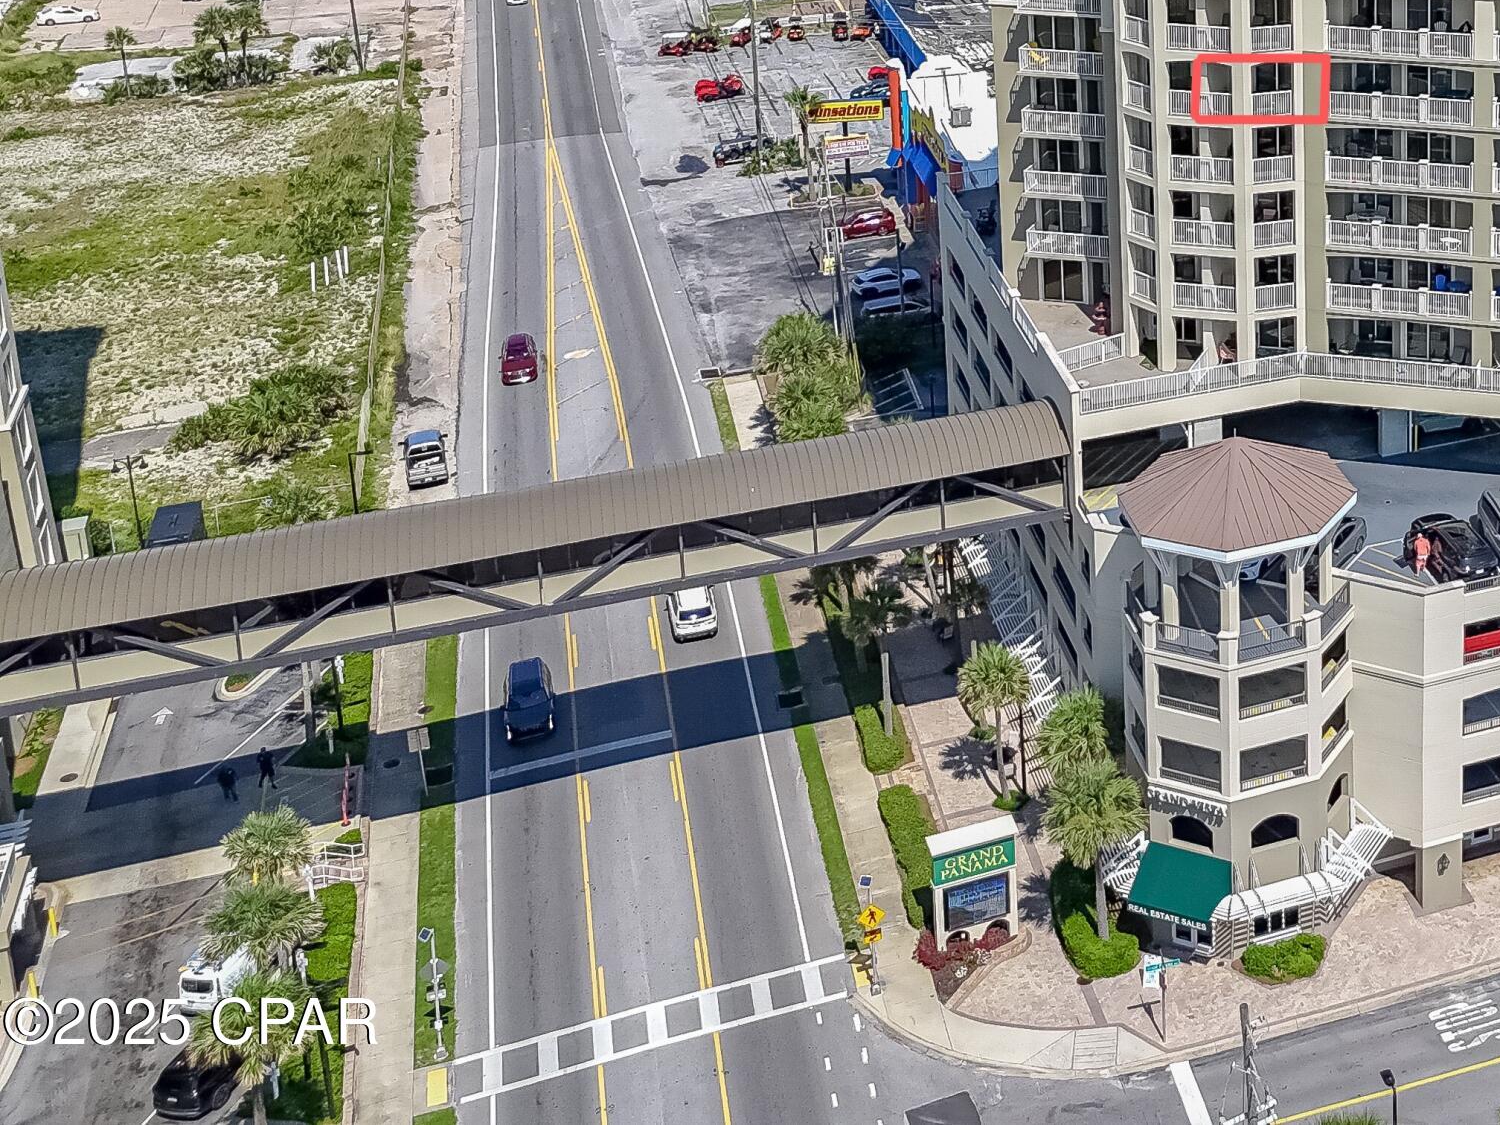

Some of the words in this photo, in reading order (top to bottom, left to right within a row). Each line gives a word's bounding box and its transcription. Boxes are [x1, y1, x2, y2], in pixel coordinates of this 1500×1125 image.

[941, 853, 1008, 880] PANAMA
[945, 845, 1004, 869] GRAND
[1128, 903, 1149, 916] REAL
[1150, 909, 1180, 924] ESTATE
[1181, 917, 1207, 931] SALES
